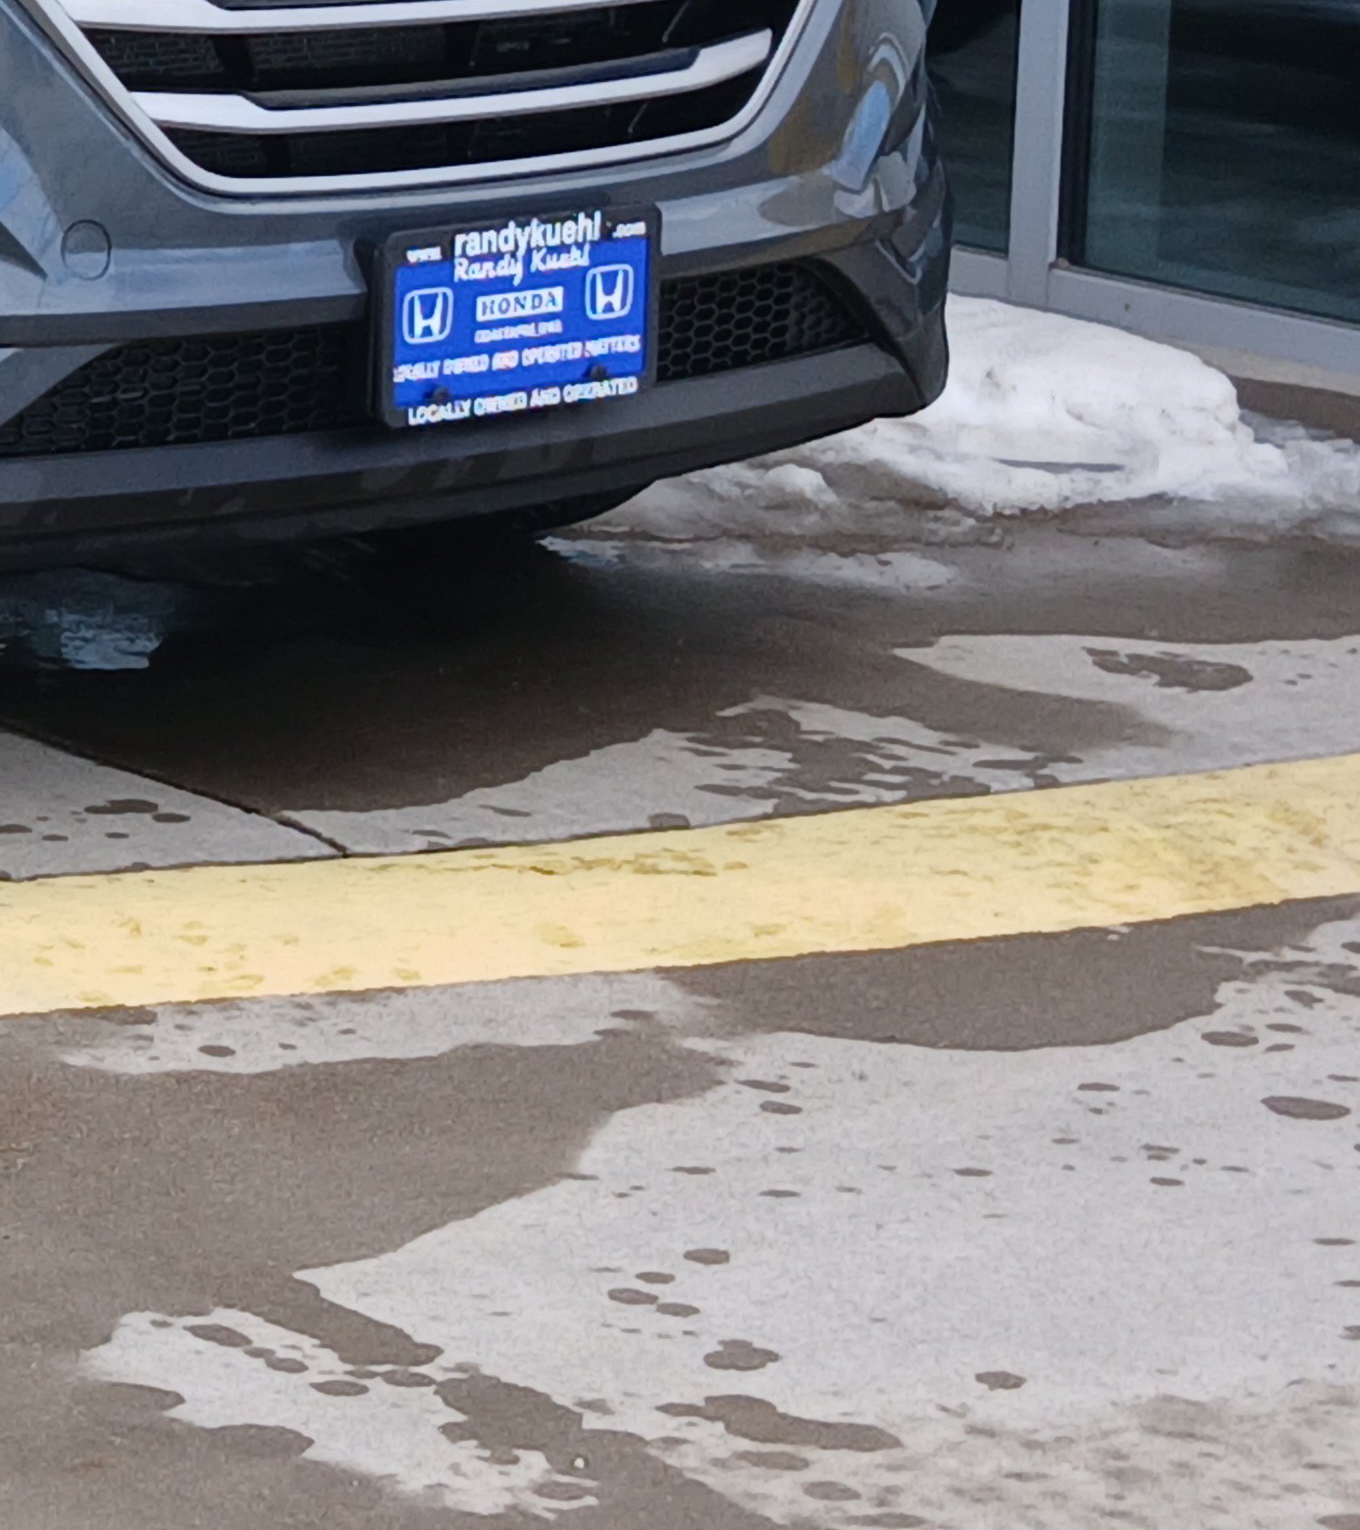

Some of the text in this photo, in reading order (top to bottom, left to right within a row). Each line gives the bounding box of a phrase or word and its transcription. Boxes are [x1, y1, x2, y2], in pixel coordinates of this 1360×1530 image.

[454, 210, 602, 258] randykuehl
[453, 254, 523, 286] Randy
[480, 290, 558, 317] HONDA
[408, 399, 471, 425] LOCALLY
[530, 387, 560, 407] AND
[563, 376, 638, 403] OPERATED
